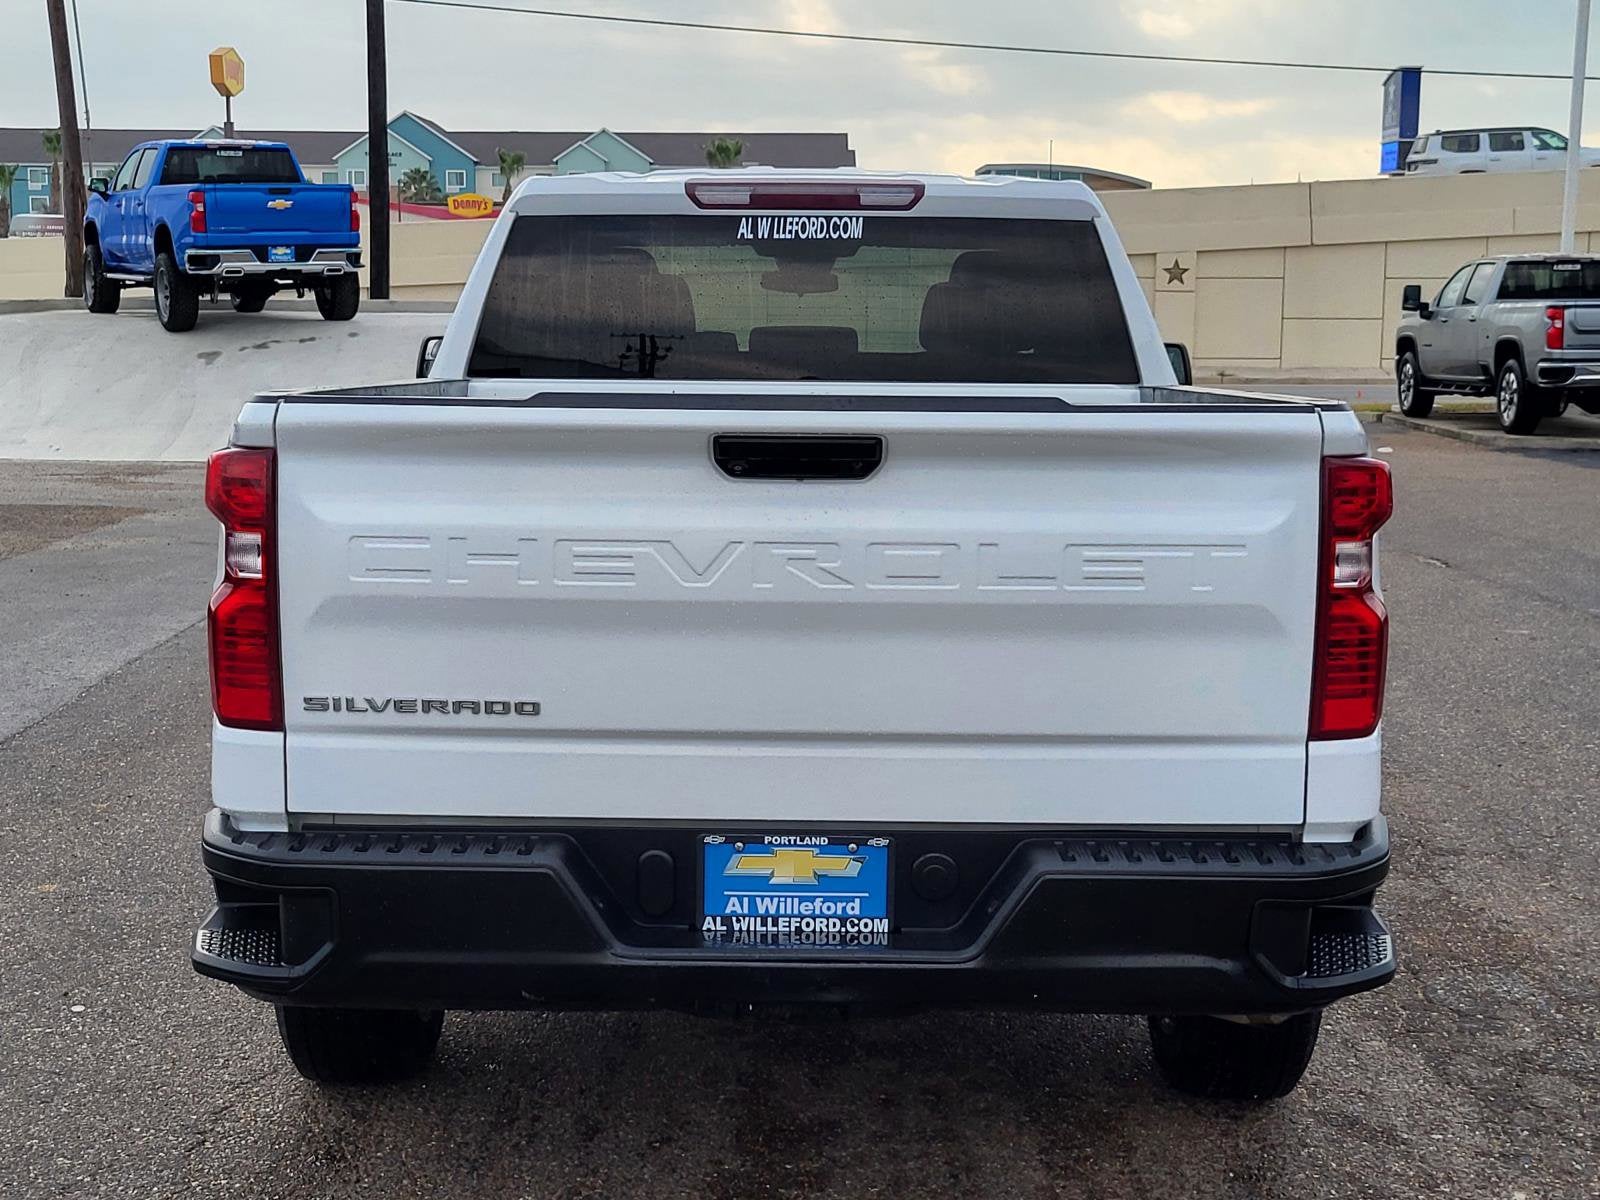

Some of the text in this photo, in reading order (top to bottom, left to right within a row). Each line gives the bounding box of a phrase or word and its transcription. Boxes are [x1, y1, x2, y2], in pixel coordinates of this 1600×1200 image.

[452, 198, 488, 211] Denny's
[736, 216, 754, 239] AL
[348, 534, 1249, 592] CHEVROLET
[303, 696, 542, 716] SILVERADO
[764, 835, 829, 846] PORTLAND
[725, 896, 861, 916] Al Willeford
[702, 916, 889, 934] AL WILLEFORD.COM
